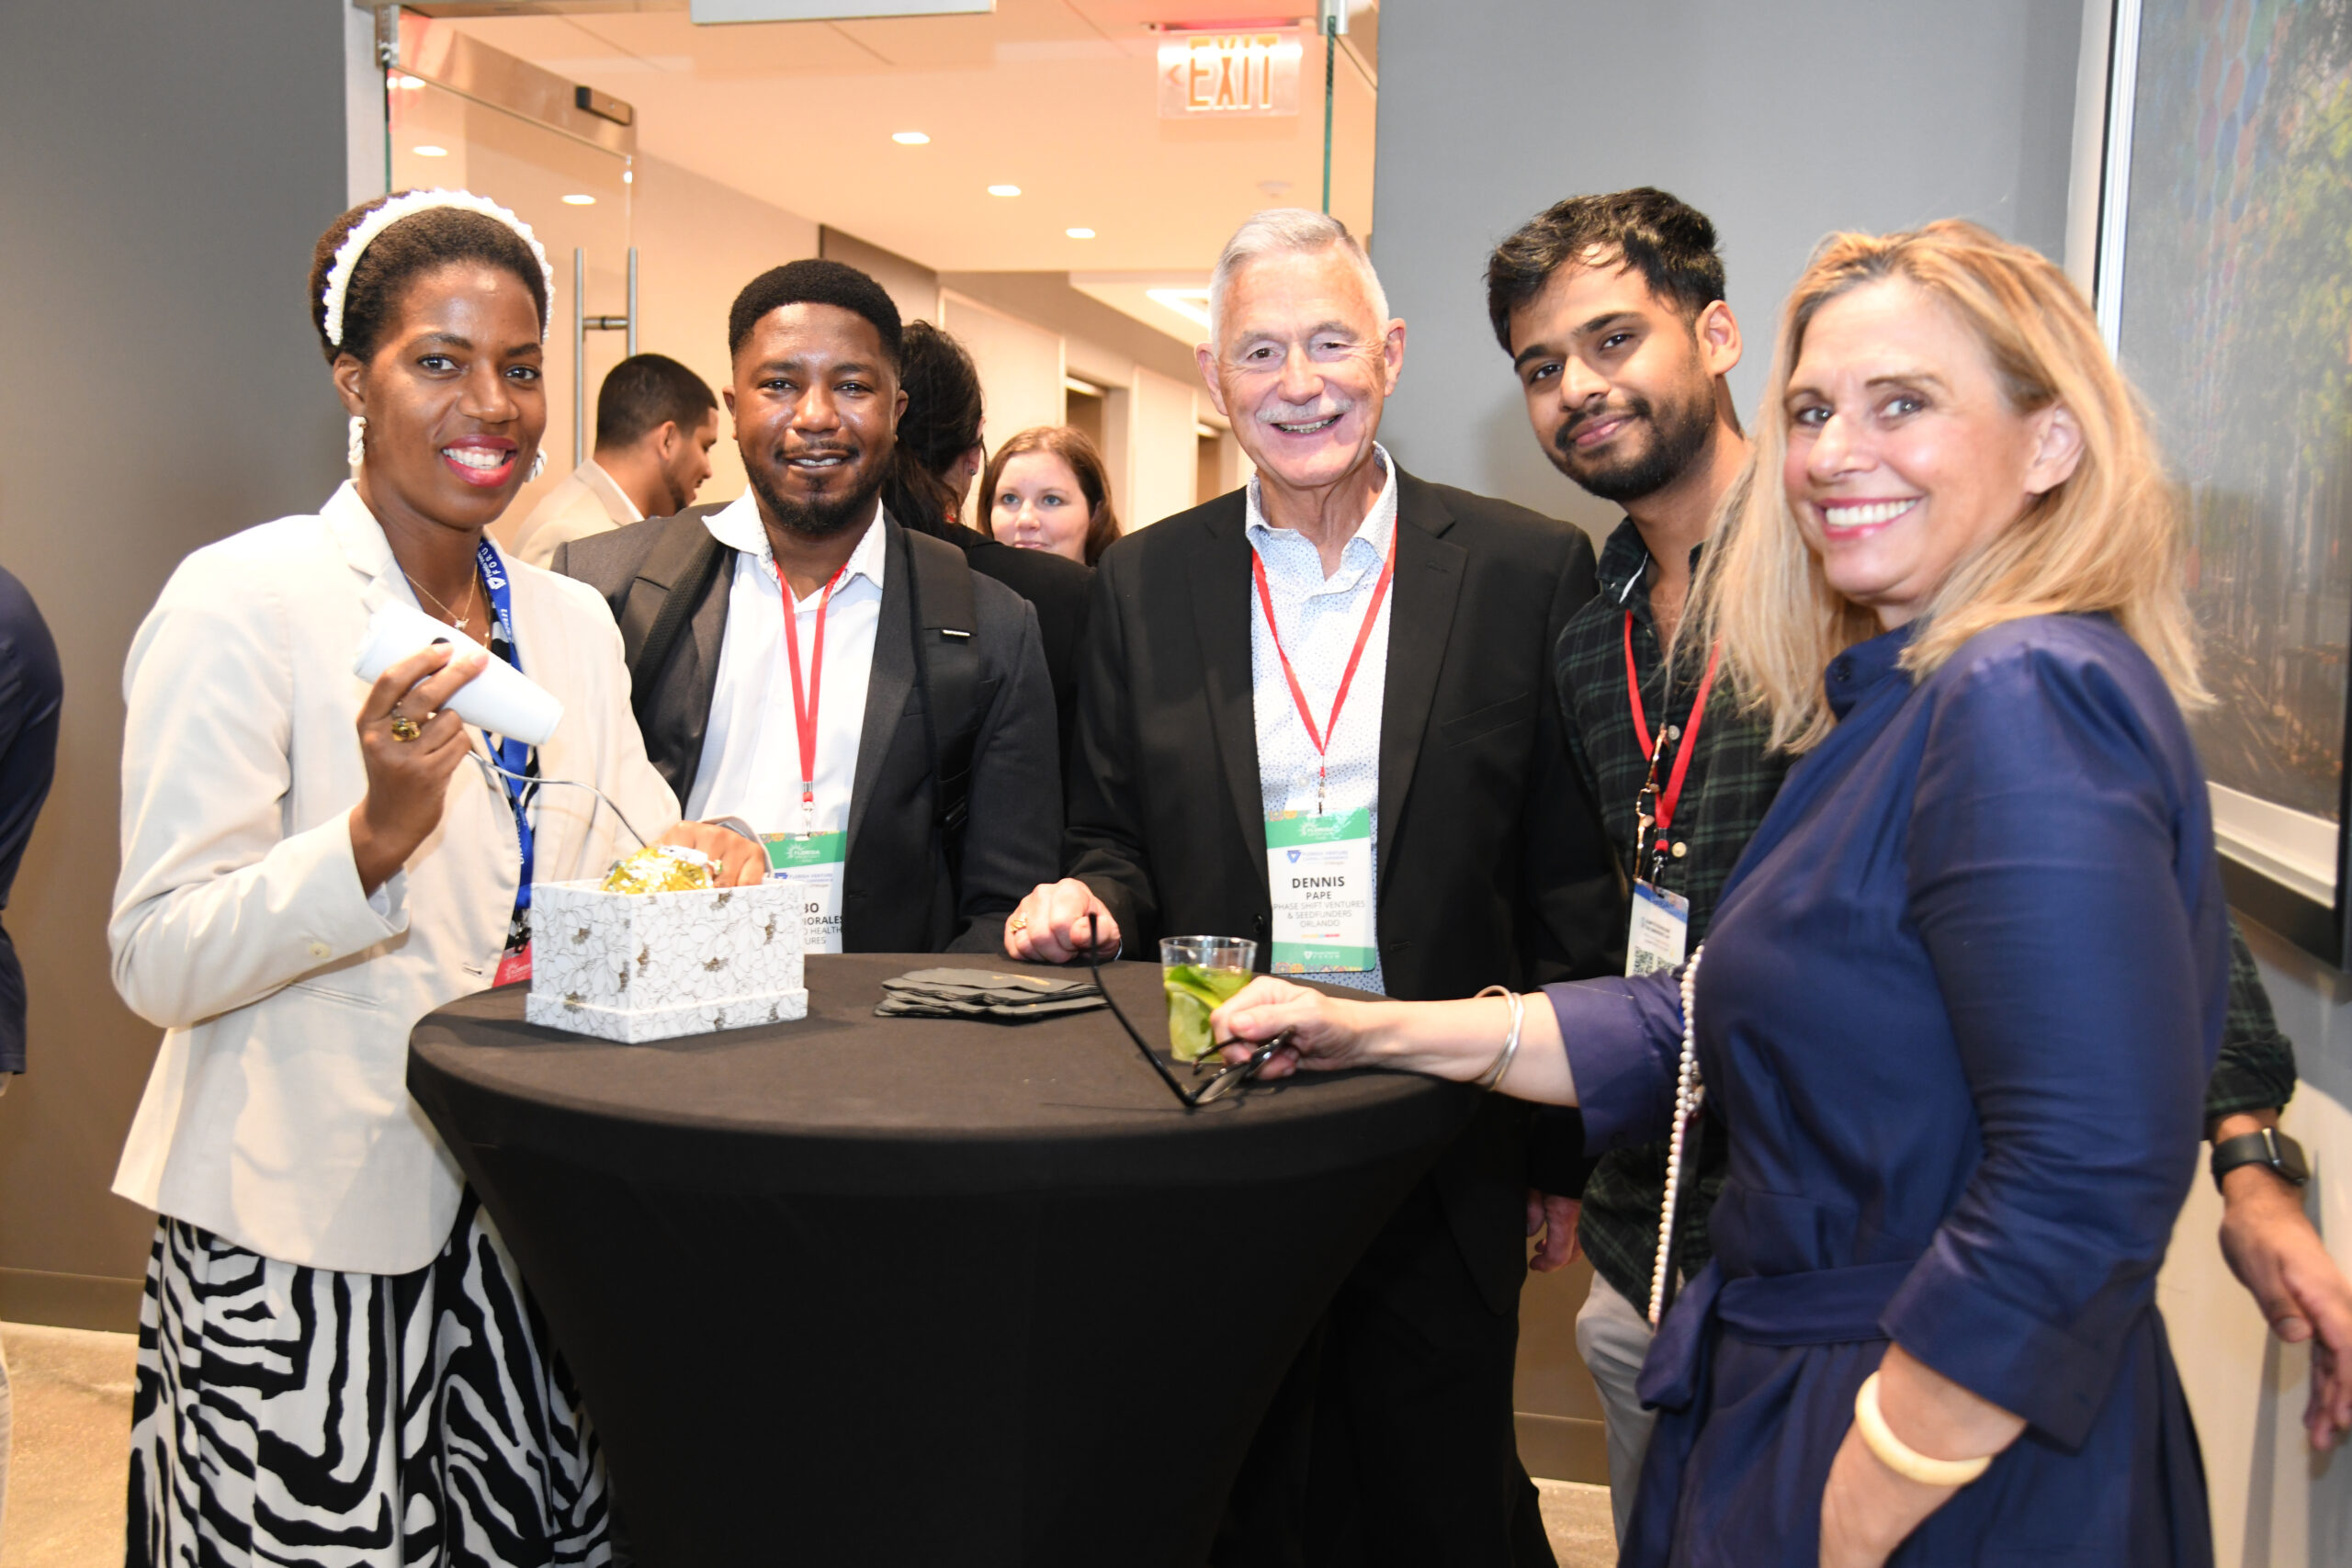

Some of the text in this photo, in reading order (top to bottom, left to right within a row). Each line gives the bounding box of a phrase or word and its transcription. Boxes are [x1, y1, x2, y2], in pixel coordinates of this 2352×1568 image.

[1188, 33, 1279, 108] EXIT
[1292, 876, 1345, 888] DENNIS
[1306, 891, 1331, 900] PAPE
[1273, 900, 1365, 910] PHASE SHIFT VENTURES
[1295, 910, 1352, 919] SEEDFUNDERS
[1300, 919, 1340, 928] ORLANDO
